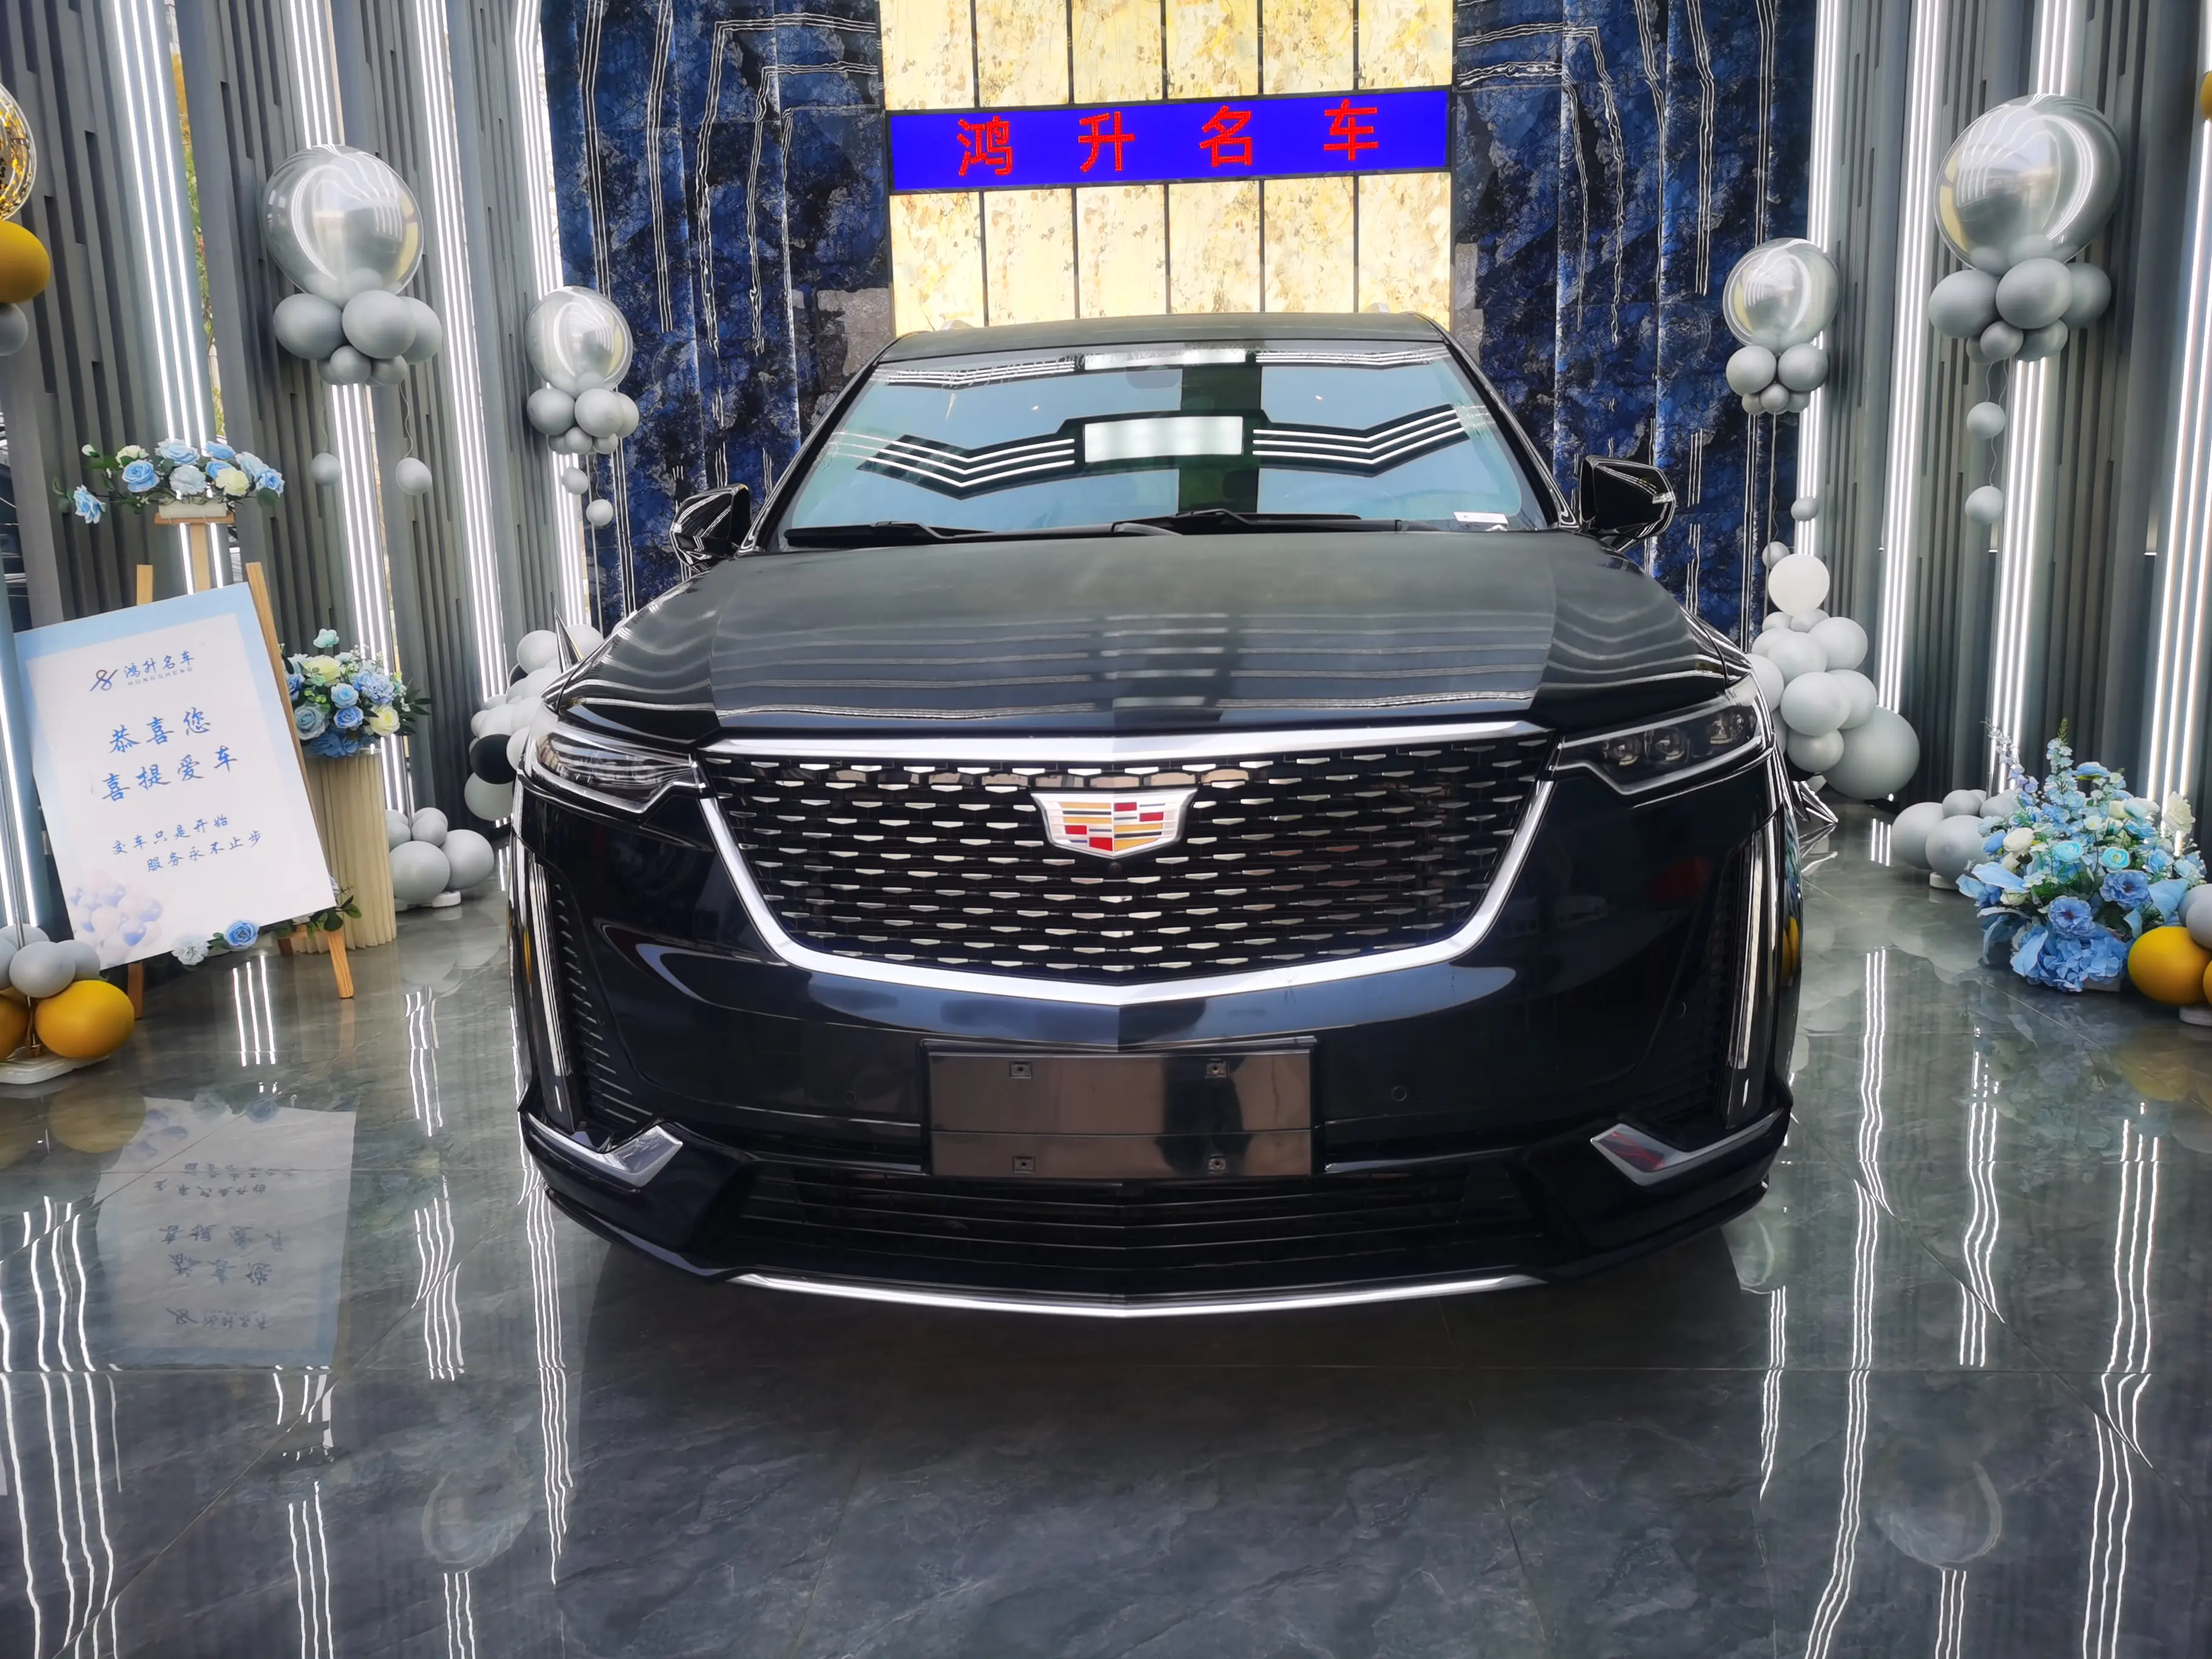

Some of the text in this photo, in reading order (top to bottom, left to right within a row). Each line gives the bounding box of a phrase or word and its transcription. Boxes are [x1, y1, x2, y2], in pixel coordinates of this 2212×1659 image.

[957, 99, 1379, 176] 鸿升名车
[124, 650, 194, 678] 鸿升名车
[128, 666, 193, 686] HONGSHENG
[109, 707, 210, 754] 恭喜您
[102, 745, 238, 802] 喜提爱车
[112, 814, 228, 855] 交车只是开始
[147, 830, 261, 872] 服务永不止步
